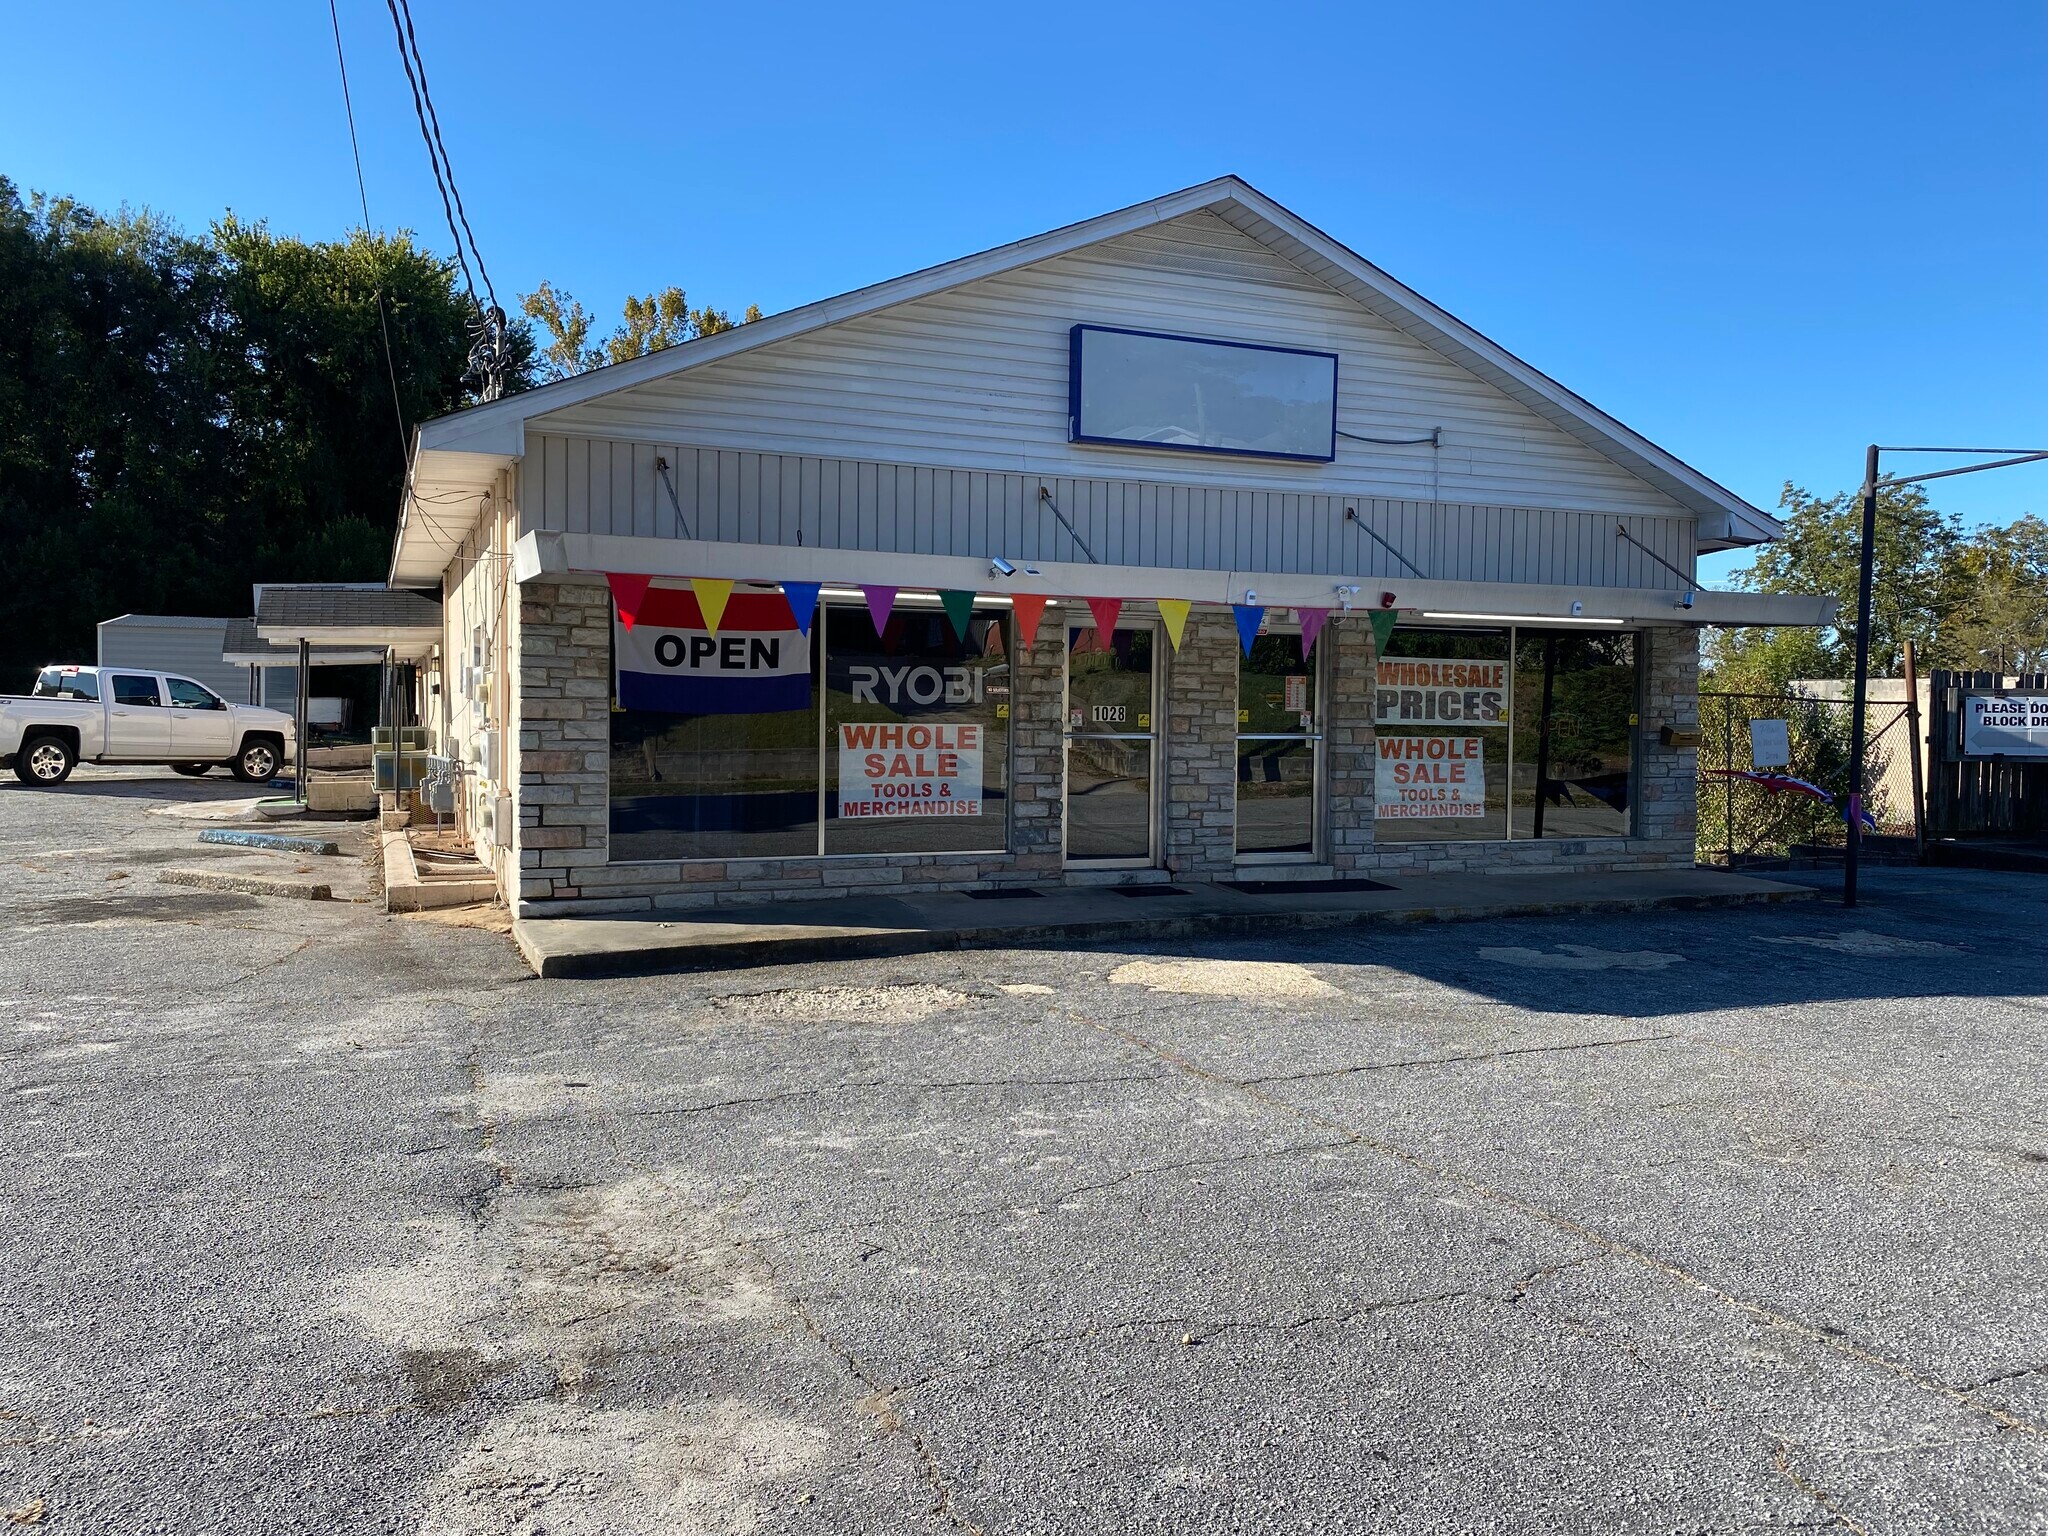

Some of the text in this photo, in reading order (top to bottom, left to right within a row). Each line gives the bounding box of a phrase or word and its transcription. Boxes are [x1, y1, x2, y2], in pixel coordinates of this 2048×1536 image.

[653, 634, 780, 670] OPEN
[848, 665, 983, 705] RYOBI
[1376, 661, 1504, 688] WHOLESALE
[1094, 706, 1125, 721] 1028
[1376, 689, 1502, 721] PRICES
[1975, 703, 2048, 714] PLEASE DO
[1983, 716, 2027, 727] BLOCK
[843, 725, 977, 750] WHOLE
[1378, 738, 1479, 760] WHOLE
[864, 753, 958, 778] SALE
[1393, 763, 1466, 784] SALE
[871, 783, 951, 798] TOOLS &
[1399, 788, 1461, 801] TOOLS &
[844, 800, 978, 817] MERCHANDISE
[1378, 803, 1481, 818] MERCHANDISE
